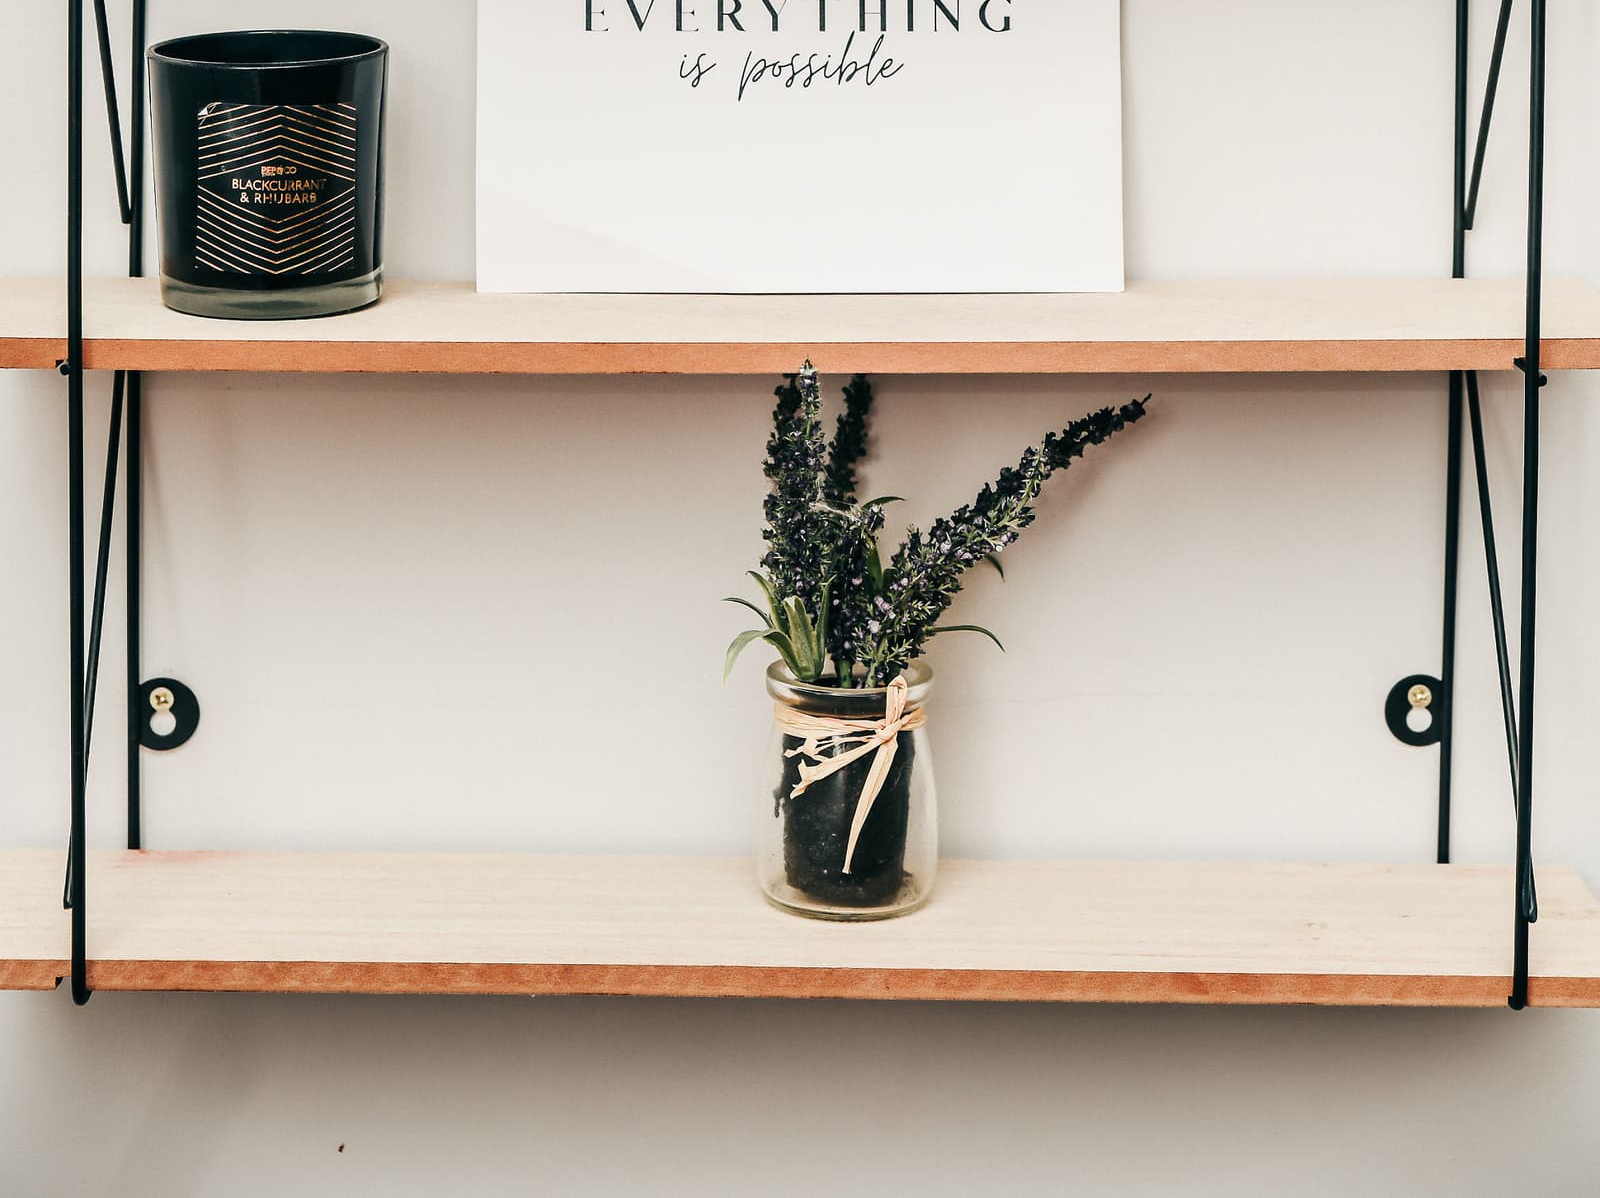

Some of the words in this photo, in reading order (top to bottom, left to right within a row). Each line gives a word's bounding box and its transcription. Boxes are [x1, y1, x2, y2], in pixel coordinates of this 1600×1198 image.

[678, 52, 717, 89] is
[737, 30, 905, 102] possible
[232, 178, 327, 192] BLACKCURRANT
[240, 192, 250, 204] &
[255, 192, 317, 205] RHUBARB
